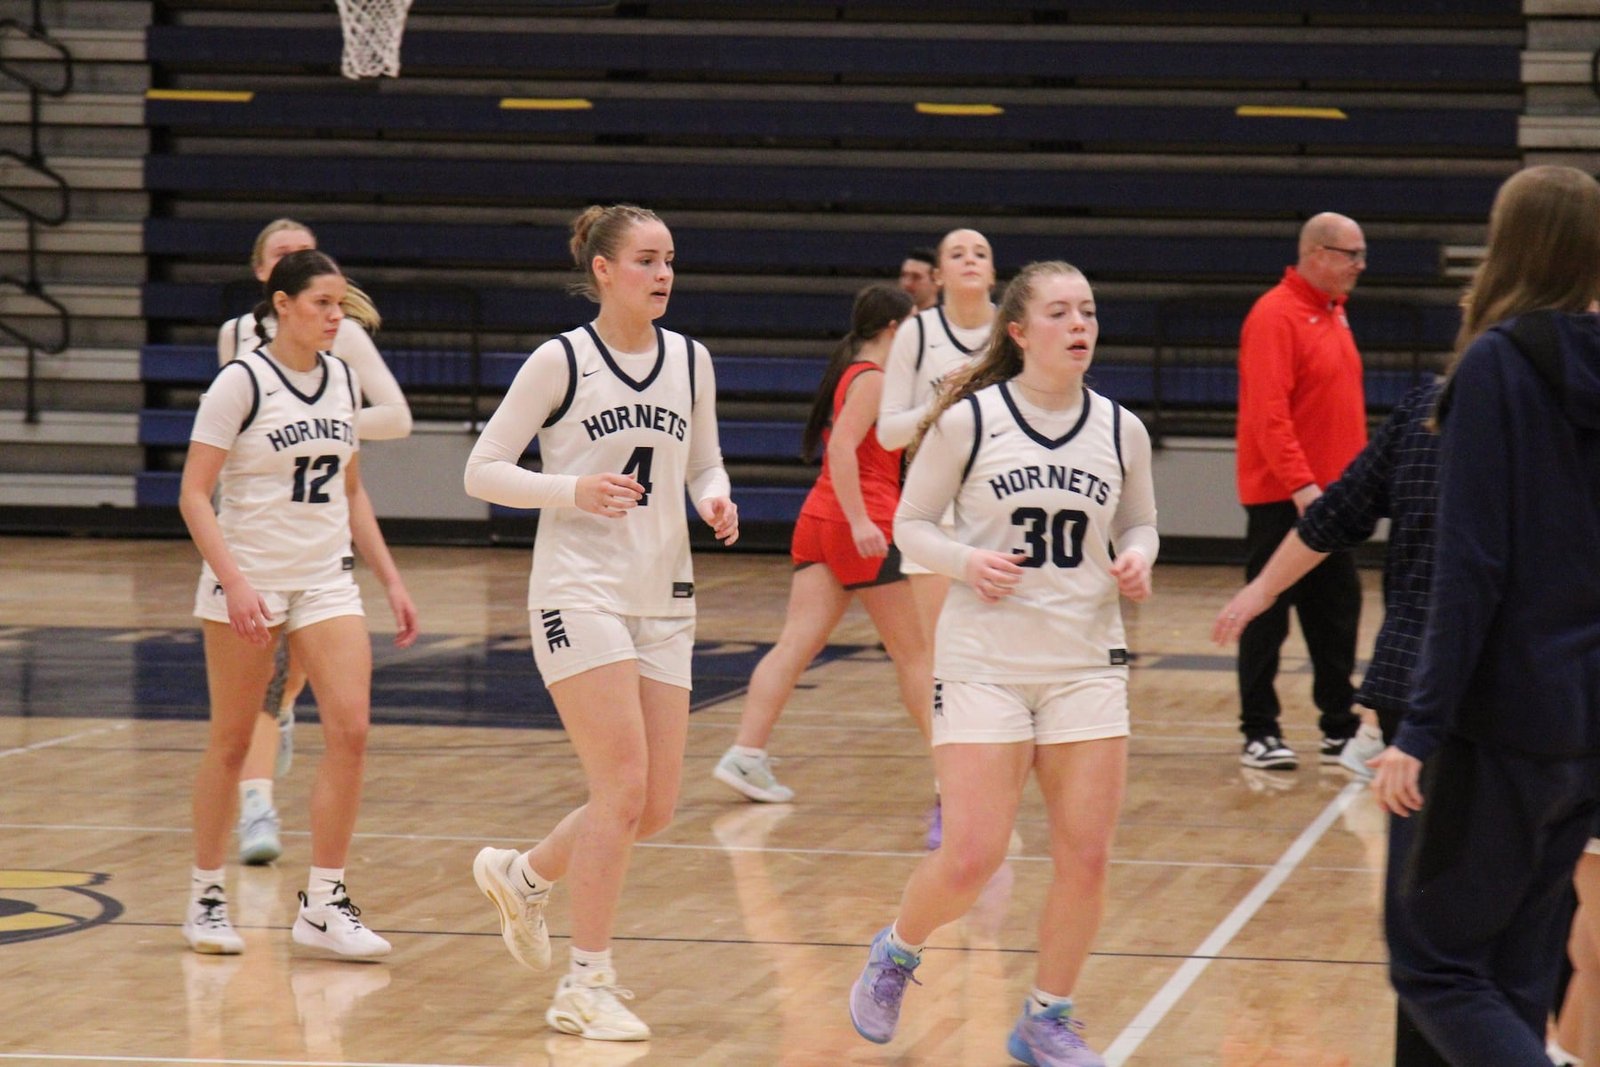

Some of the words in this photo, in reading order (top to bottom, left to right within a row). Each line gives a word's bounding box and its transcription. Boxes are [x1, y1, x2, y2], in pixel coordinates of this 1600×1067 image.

[582, 404, 686, 441] HORNETS
[291, 455, 339, 503] 12
[622, 447, 654, 506] 4
[989, 465, 1110, 505] HORNETS
[1011, 507, 1088, 568] 30
[541, 609, 570, 654] INE
